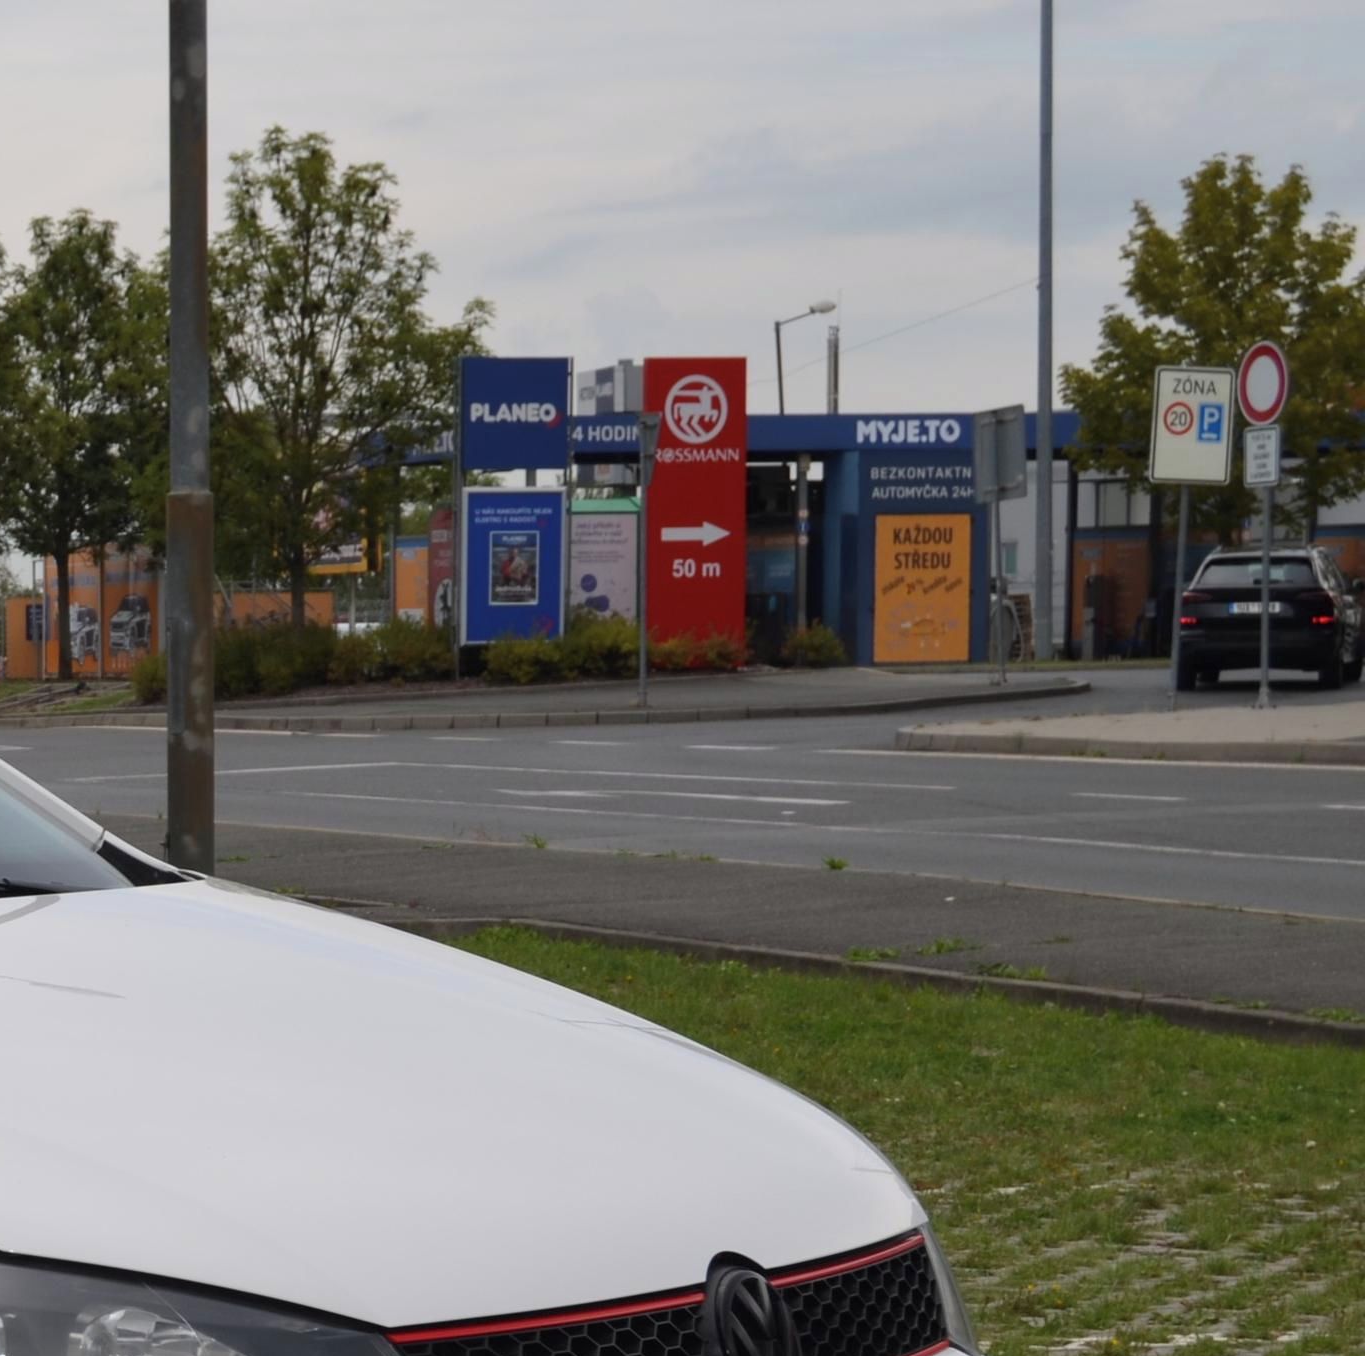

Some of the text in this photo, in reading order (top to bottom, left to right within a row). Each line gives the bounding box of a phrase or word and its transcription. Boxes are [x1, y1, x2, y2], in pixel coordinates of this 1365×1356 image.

[1172, 375, 1217, 396] ZÓNA
[470, 402, 556, 423] PLANEO
[1170, 410, 1188, 427] 20
[1203, 406, 1219, 431] P
[567, 425, 584, 442] 4
[855, 418, 961, 444] MYJE.TO
[655, 448, 740, 463] ROSSMANN
[869, 466, 972, 480] BEZKONTAKTN
[871, 484, 949, 499] AUTOMYČKA
[892, 523, 953, 545] KAŽDOU
[672, 558, 721, 578] 50 m
[893, 549, 952, 570] STŘEDU
